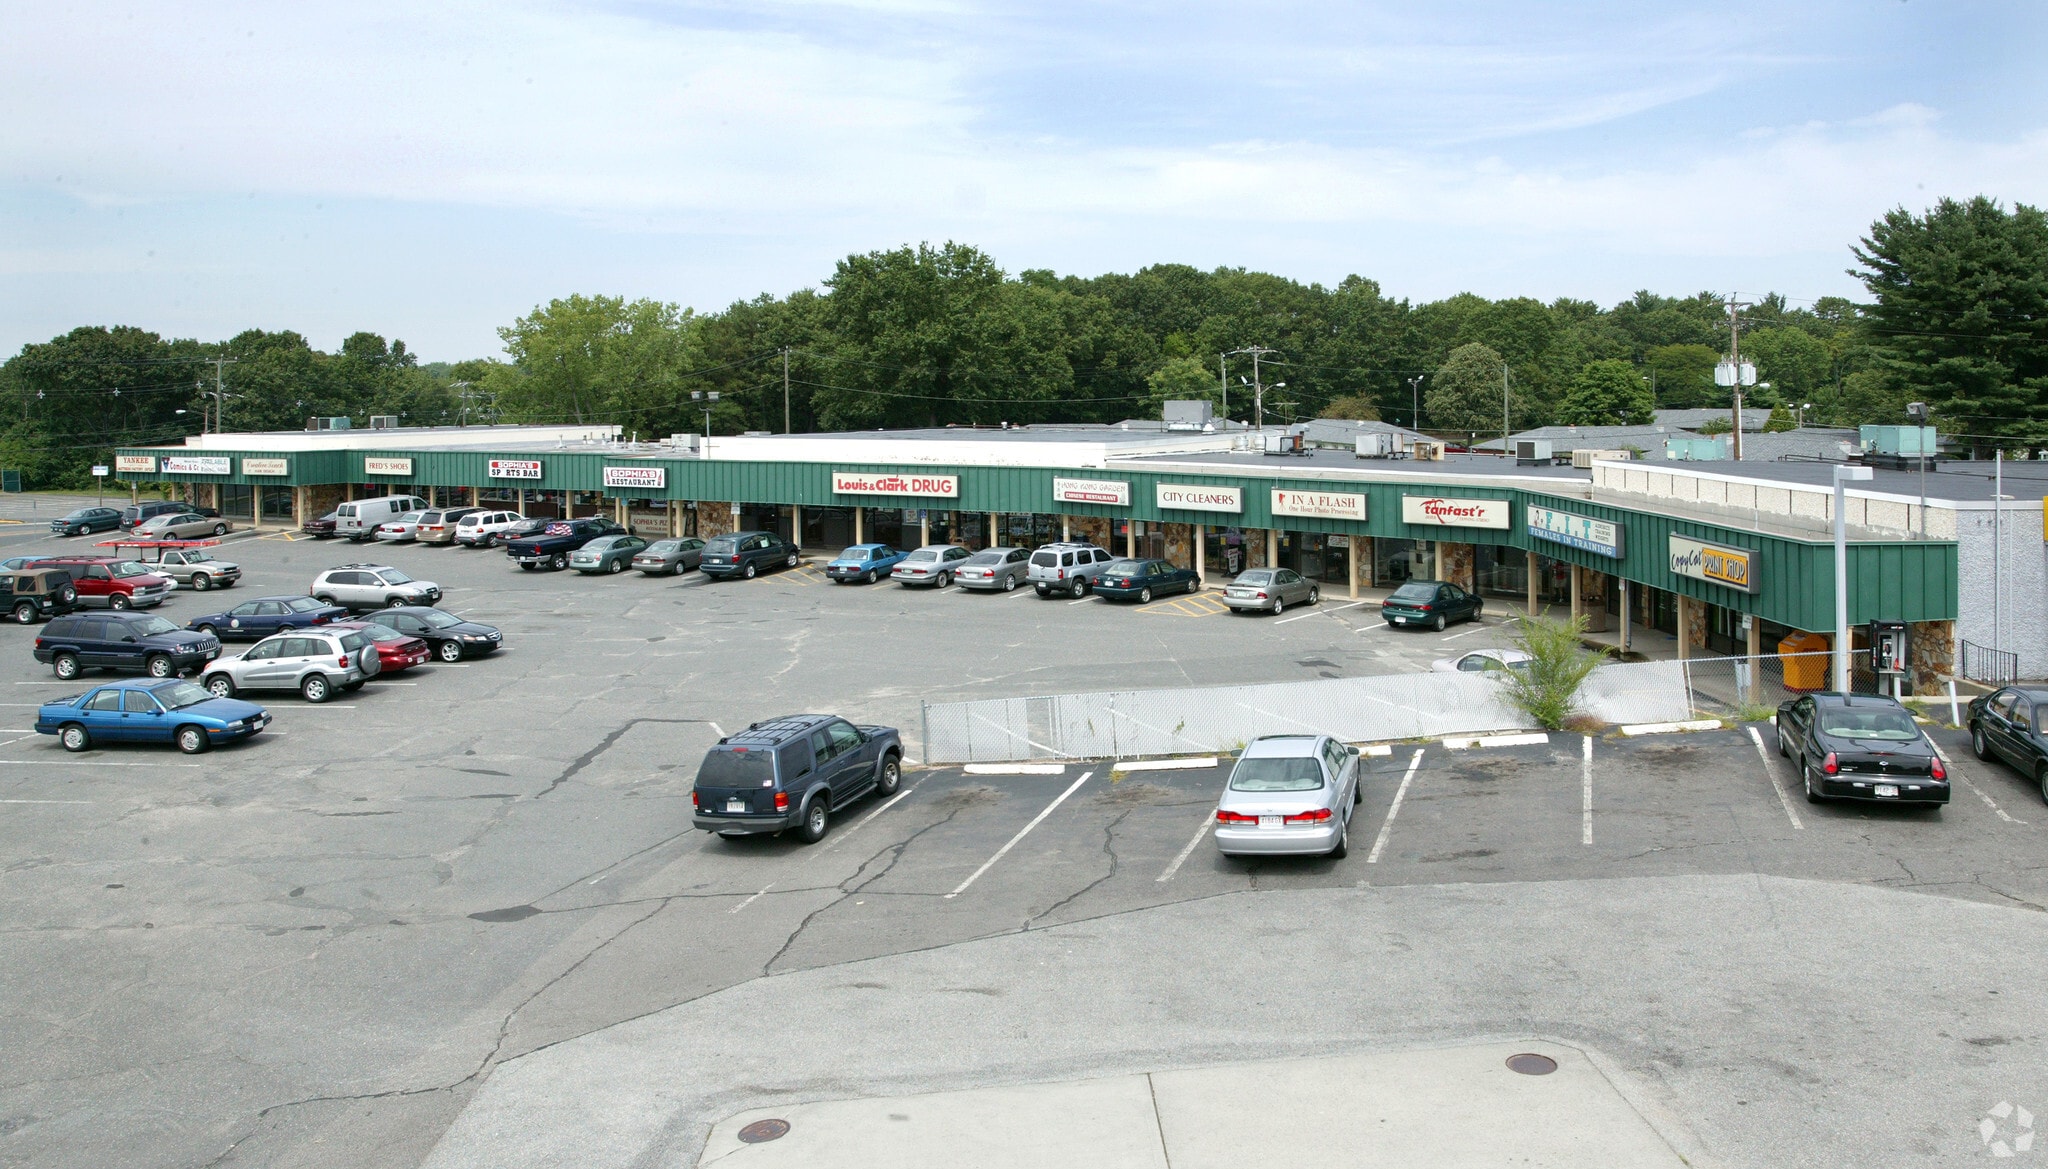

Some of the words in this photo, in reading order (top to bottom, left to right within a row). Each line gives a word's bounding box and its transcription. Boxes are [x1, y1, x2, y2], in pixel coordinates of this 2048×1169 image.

[170, 461, 187, 471] Comics
[369, 462, 389, 470] FRED'S
[498, 461, 533, 469] SOPHIA'S
[612, 470, 656, 478] SOPHIA'S
[912, 479, 952, 493] DRUG
[1100, 484, 1126, 493] GARDEN
[1085, 494, 1117, 502] RESTAURANT
[1163, 491, 1184, 502] CITY
[1186, 493, 1235, 506] CLEANERS
[1292, 494, 1304, 505] IN
[1307, 496, 1315, 506] A
[1319, 496, 1356, 508] FLASH
[1300, 505, 1313, 513] Hour
[1314, 506, 1330, 514] Photo
[1331, 507, 1359, 516] Processing
[633, 518, 658, 526] SOPHIA'S
[1530, 526, 1561, 542] FEMALES
[1562, 535, 1573, 544] IN
[1574, 537, 1612, 556] TRAINING
[1704, 554, 1724, 576] PRINT
[1726, 558, 1745, 582] SHOP
